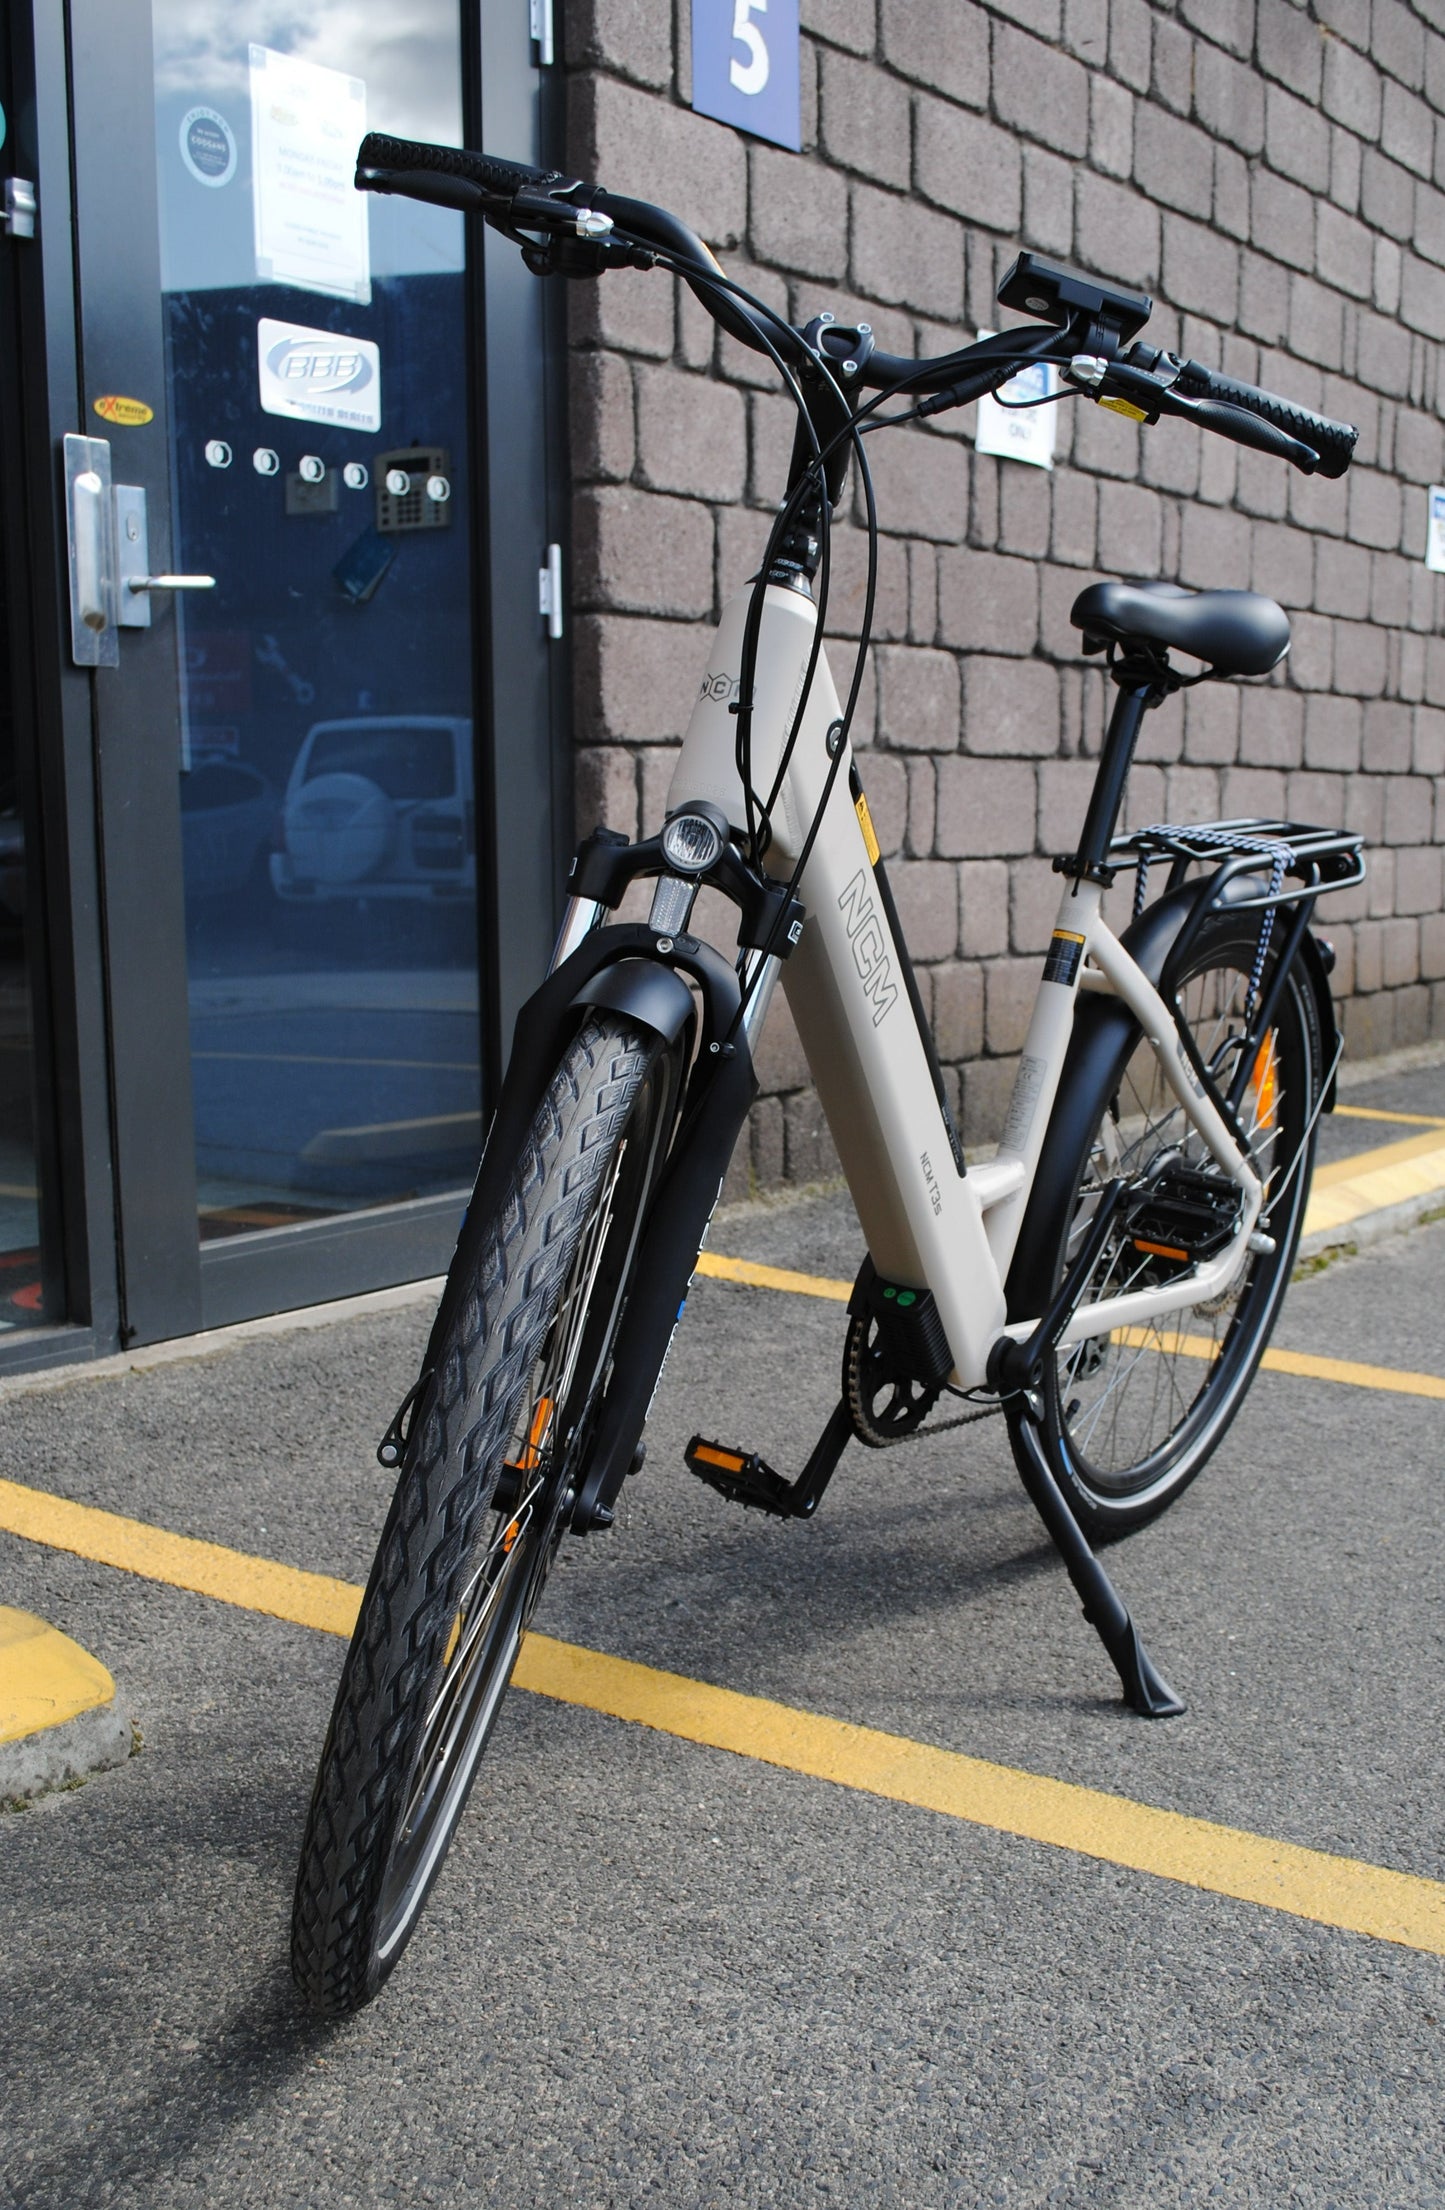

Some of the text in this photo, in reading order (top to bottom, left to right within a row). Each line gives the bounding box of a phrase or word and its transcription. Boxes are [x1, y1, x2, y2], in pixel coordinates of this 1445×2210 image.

[730, 0, 770, 96] 5
[285, 351, 360, 379] BBB
[837, 868, 899, 1028] NCM
[920, 1151, 935, 1185] NCM
